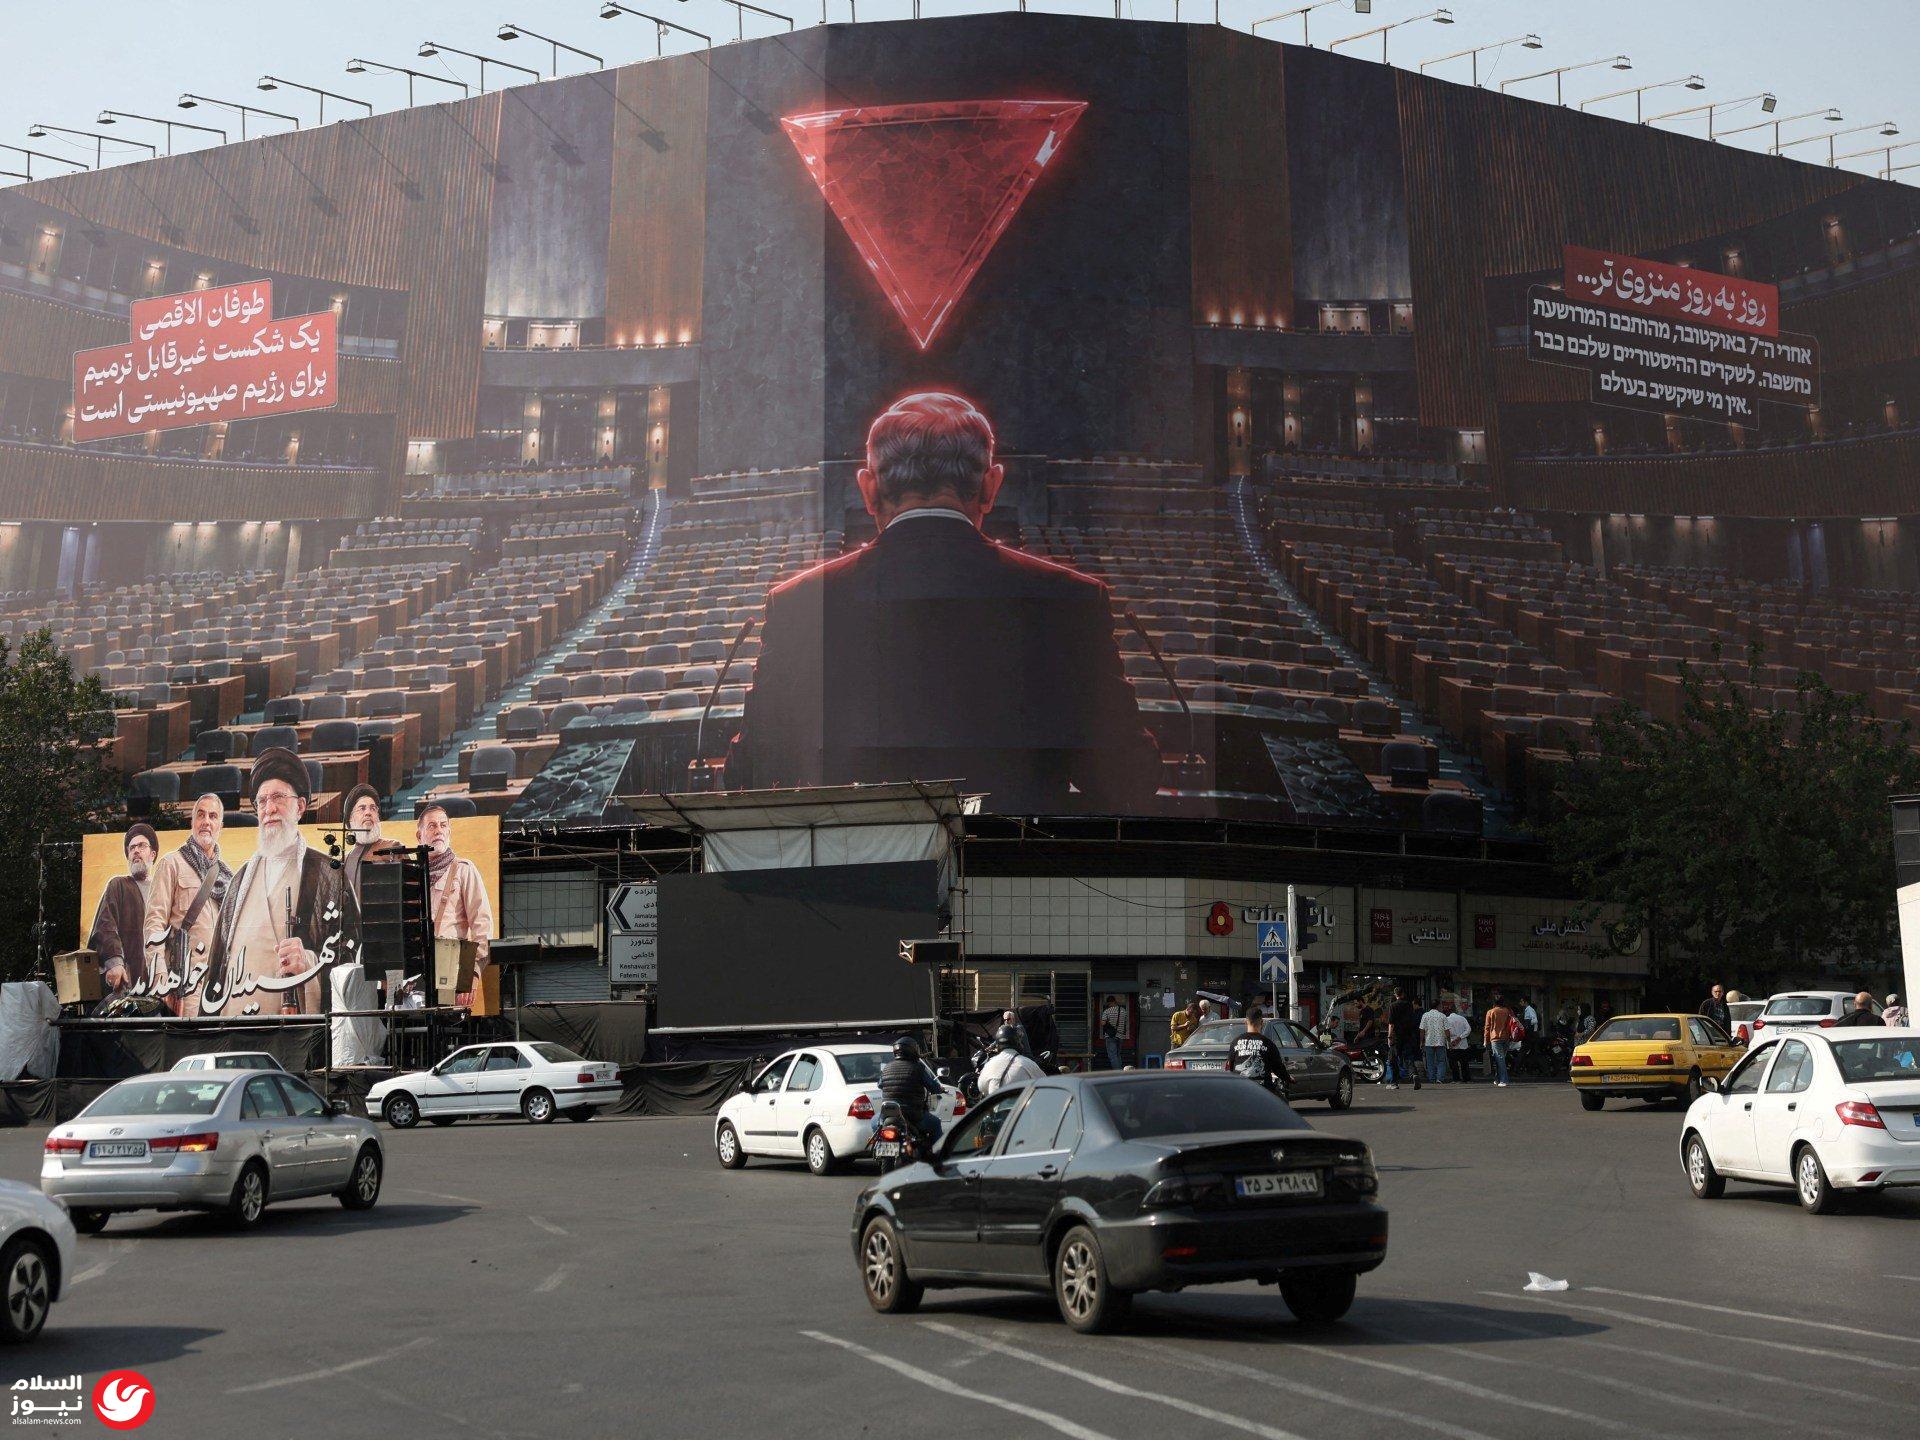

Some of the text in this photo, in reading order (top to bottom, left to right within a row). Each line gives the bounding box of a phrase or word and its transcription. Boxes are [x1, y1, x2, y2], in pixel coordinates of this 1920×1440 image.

[1616, 268, 1680, 305] منزوی
[1680, 279, 1712, 316] روز
[139, 288, 265, 341] طوفان الاقصی
[1533, 299, 1607, 328] המרושעת
[1714, 285, 1736, 320] به
[1735, 290, 1767, 327] روز
[289, 319, 321, 353] یک
[1534, 330, 1565, 352] כבר
[1609, 312, 1670, 340] מהותכם
[213, 327, 285, 362] شکست
[1567, 334, 1610, 359] שלכם
[1612, 344, 1697, 375] ההיסטוריים
[1776, 343, 1812, 365] אחרי
[83, 352, 133, 394] ترمیم
[1600, 370, 1648, 397] בעולם
[1700, 359, 1756, 386] לשקרים
[80, 361, 327, 424] برای رژیم صهیونیستی است
[1649, 382, 1704, 408] שיקשיב
[1706, 391, 1723, 410] מי
[1411, 927, 1450, 944] ساعتی
[1535, 918, 1556, 935] ملی
[200, 900, 343, 1015] شهیدان
